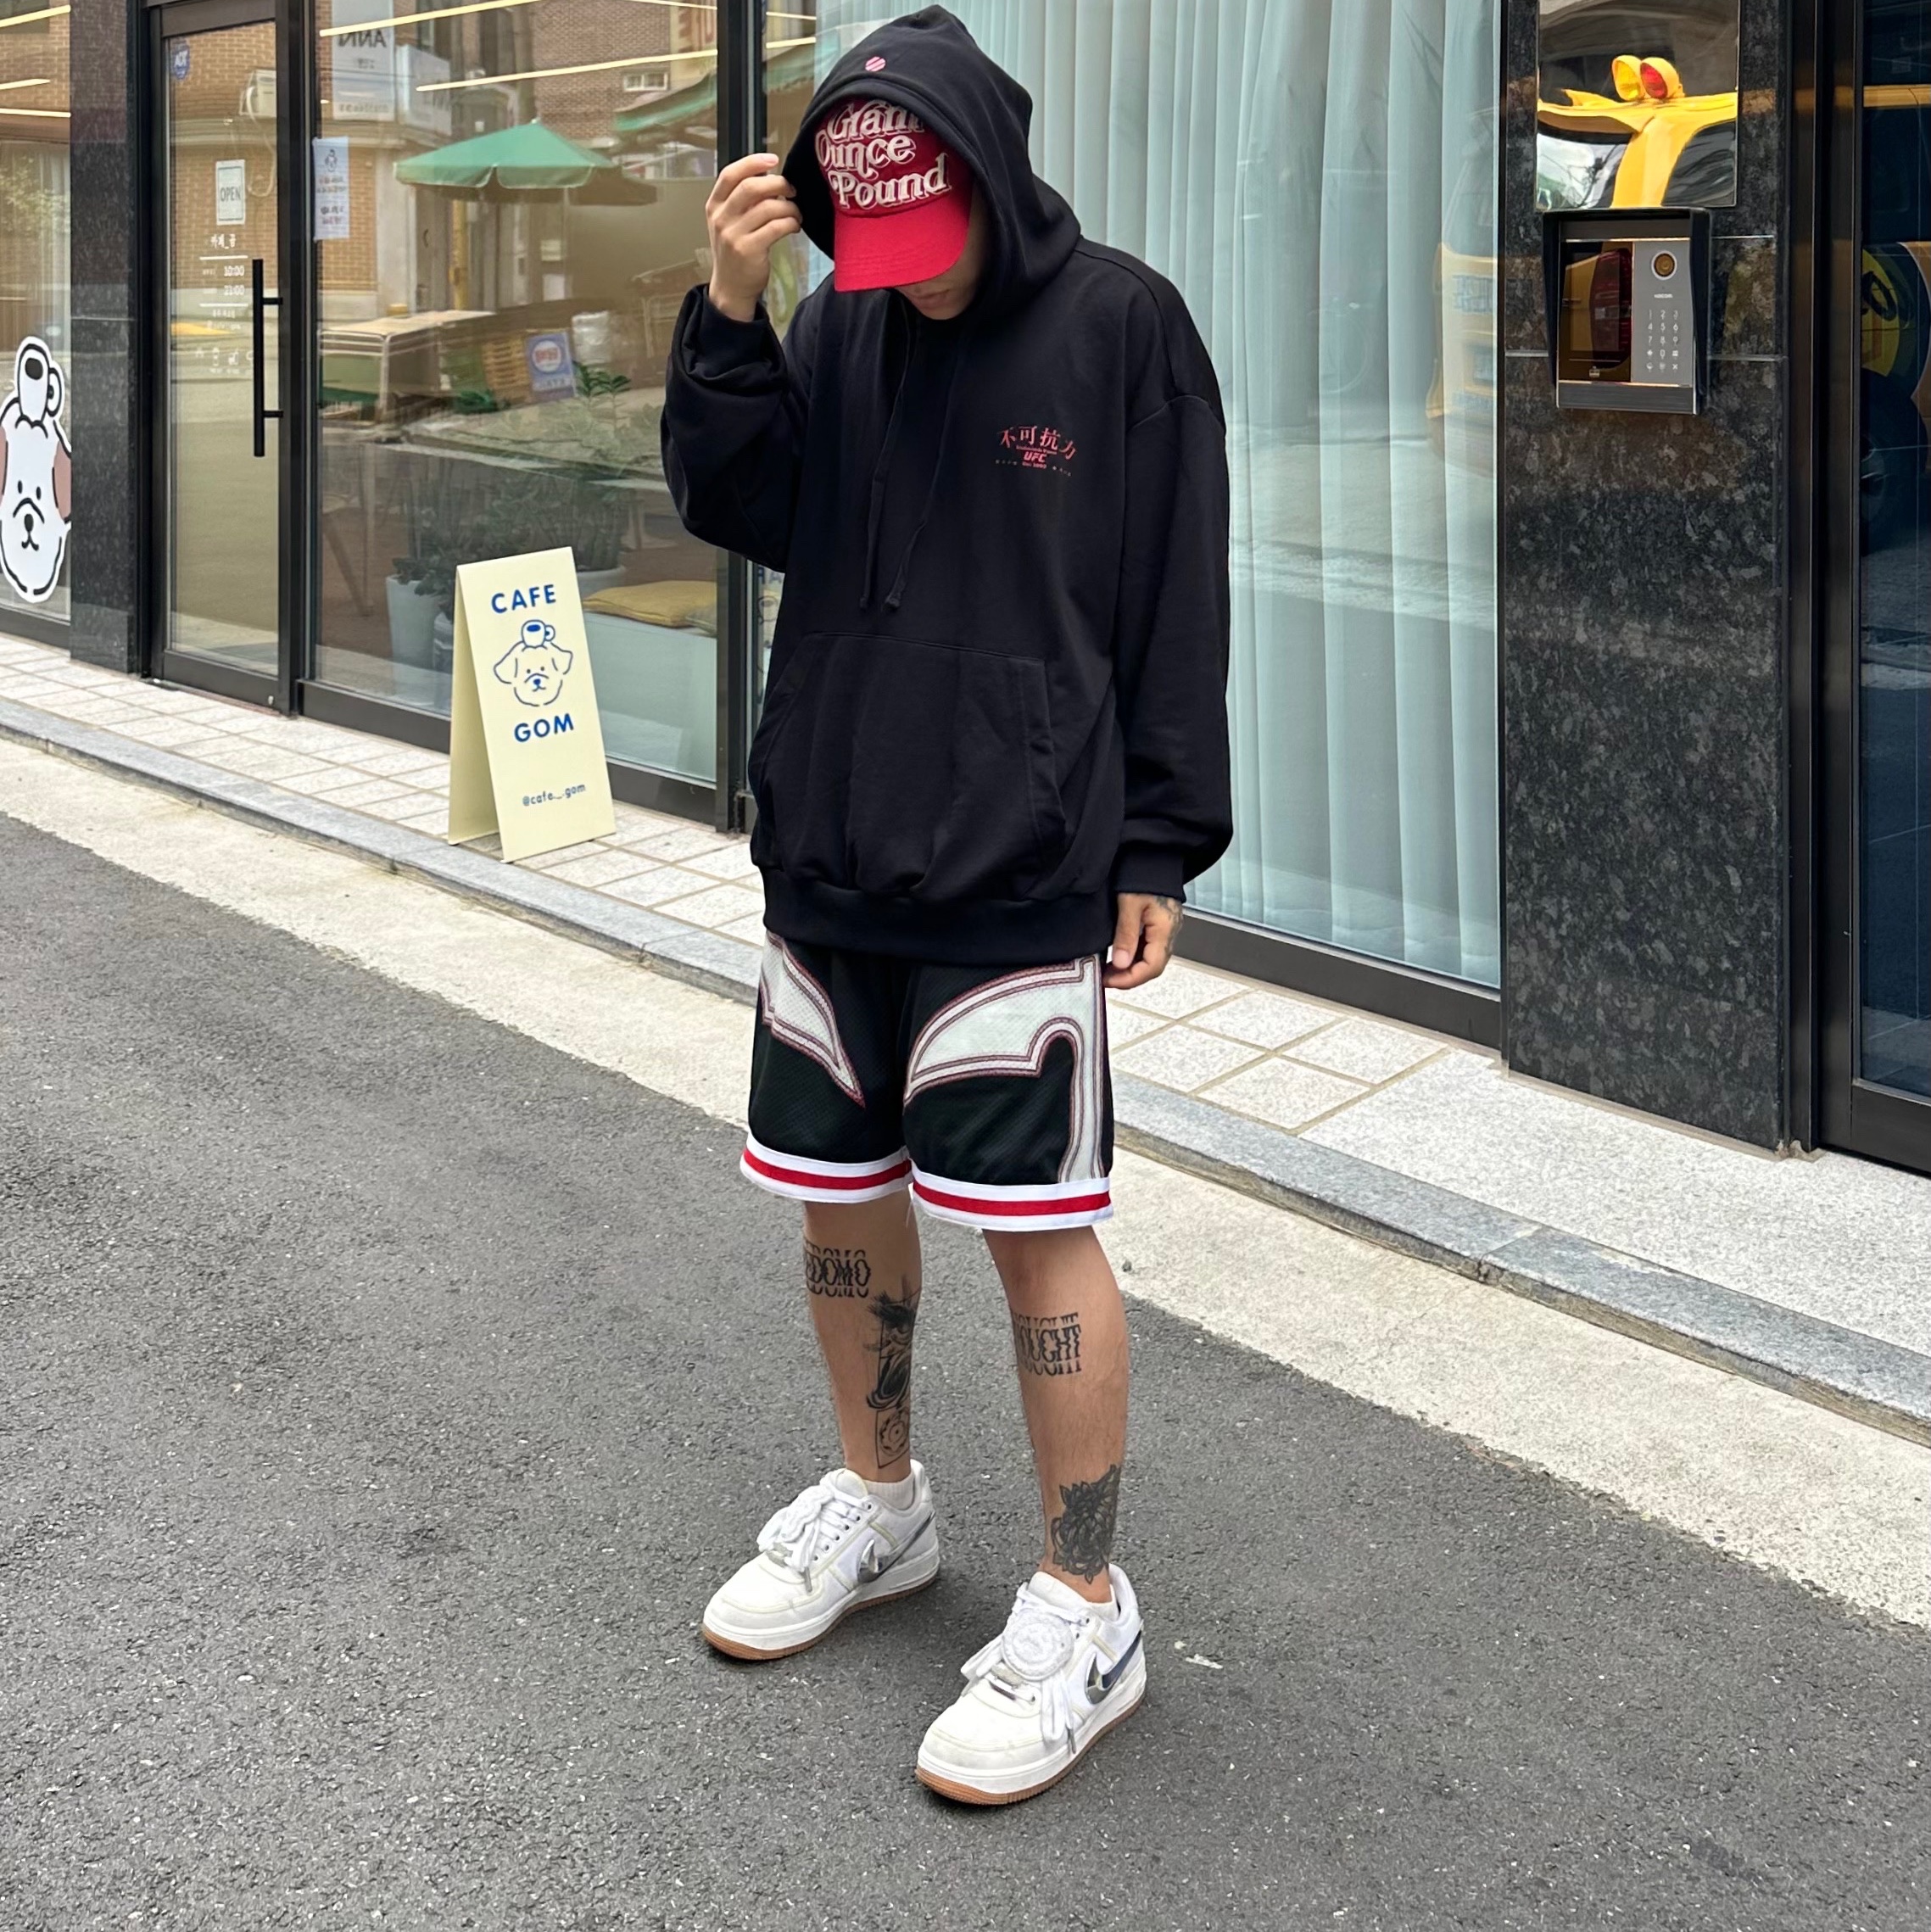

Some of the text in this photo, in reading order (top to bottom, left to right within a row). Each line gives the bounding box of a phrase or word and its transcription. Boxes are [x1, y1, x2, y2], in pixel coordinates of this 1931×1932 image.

[815, 130, 917, 181] Ounce
[220, 186, 242, 202] OPEN
[828, 153, 952, 209] Pound
[998, 426, 1076, 460] 不可抗力
[1023, 451, 1047, 463] UFC
[491, 584, 557, 614] CAFE
[514, 713, 575, 743] GOM
